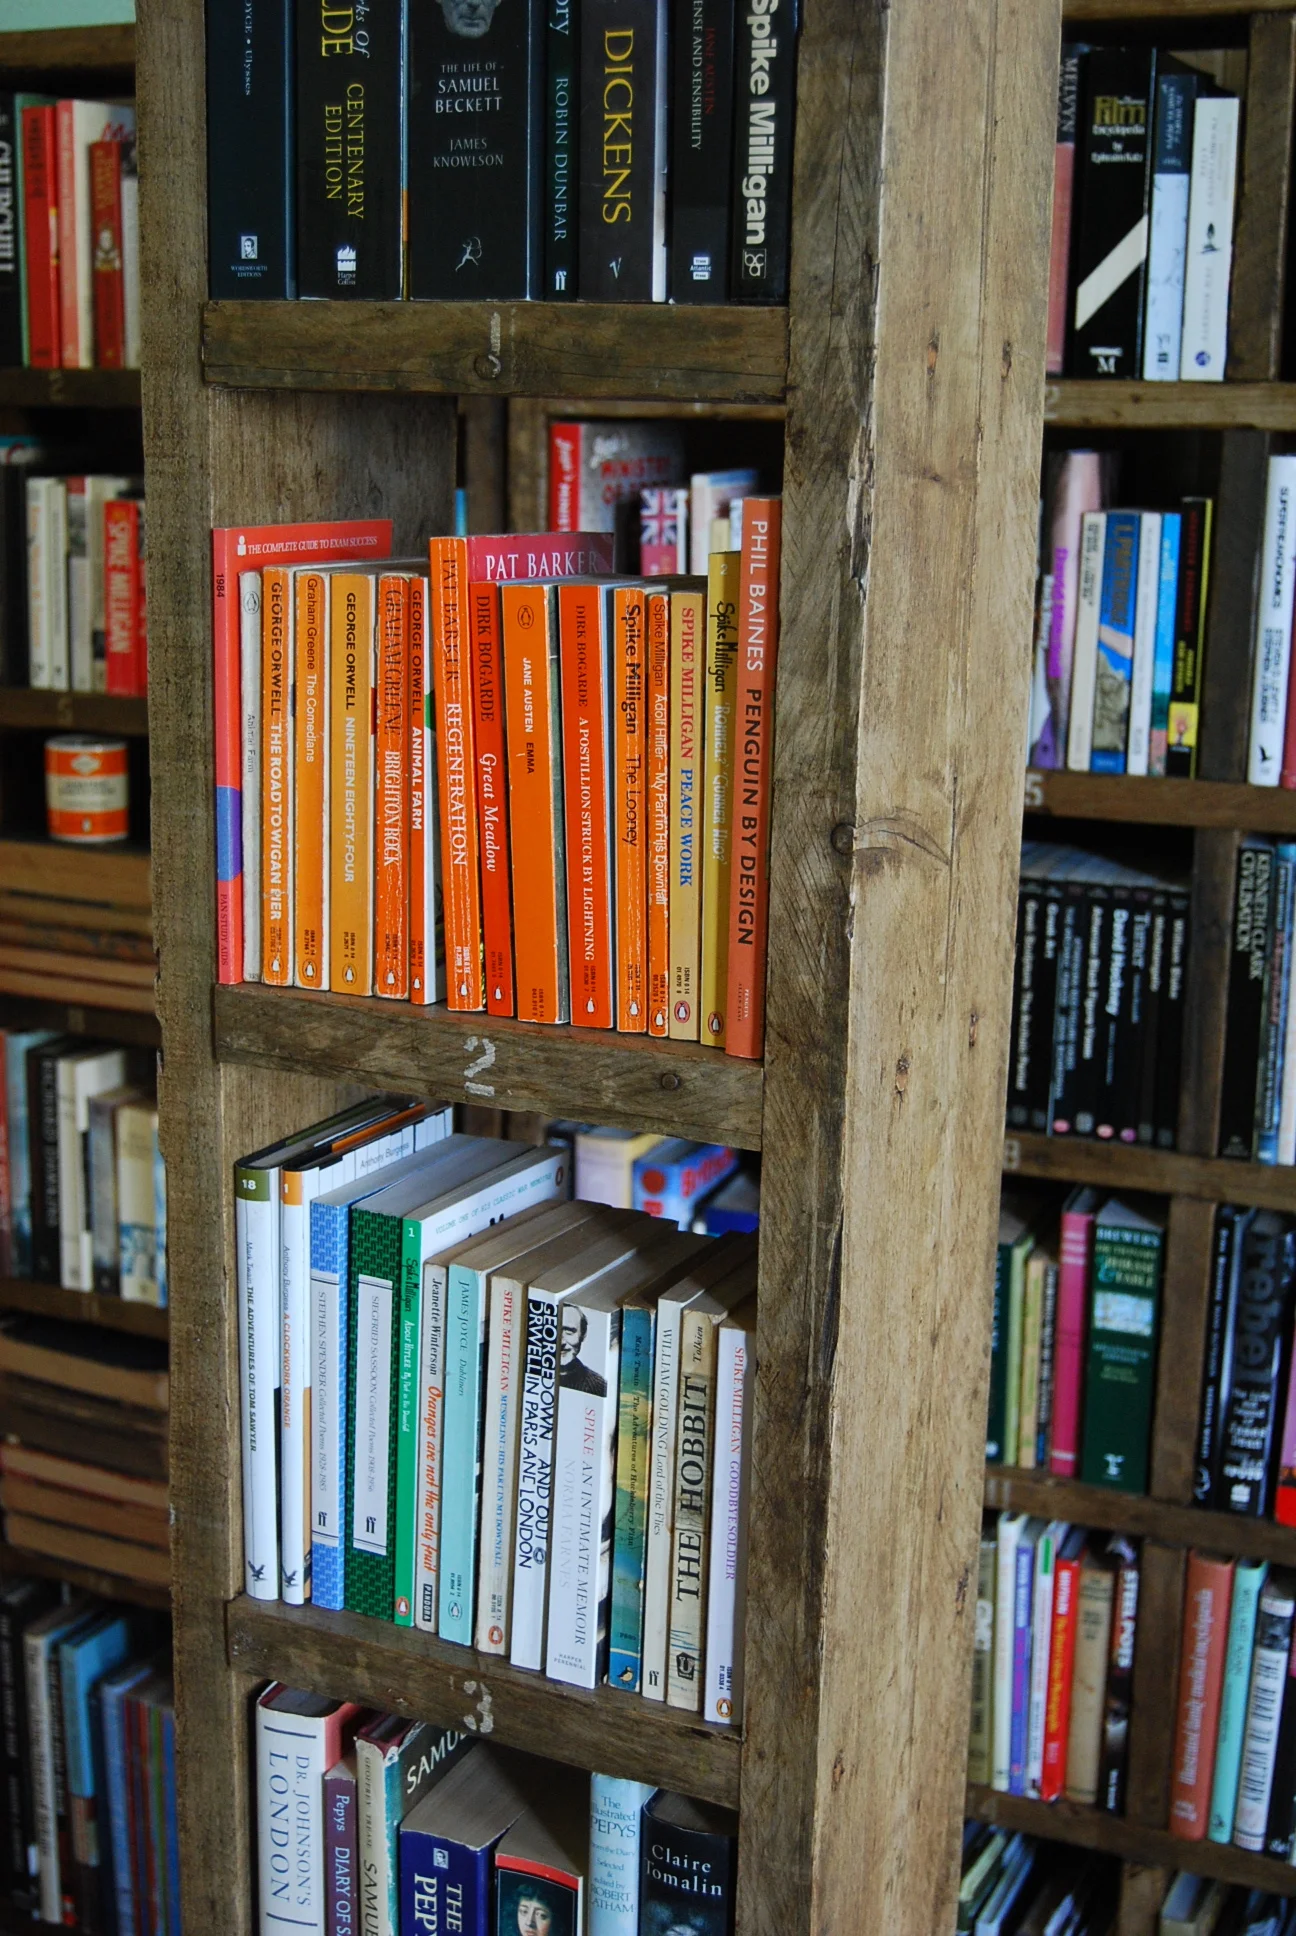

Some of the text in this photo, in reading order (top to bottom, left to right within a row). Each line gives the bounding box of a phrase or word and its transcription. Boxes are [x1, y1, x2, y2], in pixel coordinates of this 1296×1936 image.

[435, 97, 502, 114] BECKETT
[438, 76, 500, 94] SAMUEL
[441, 62, 496, 73] THE LIFE OF
[691, 37, 703, 149] AND SENSIBILITY
[1059, 57, 1079, 133] MELVYN
[325, 105, 342, 200] EDITION
[347, 83, 364, 219] CENTENARY
[433, 155, 504, 168] KNOWLSON
[450, 138, 487, 151] JAMES
[554, 78, 569, 241] ROBIN DUNBAR
[603, 28, 634, 223] DICKENS
[742, 0, 778, 245] Spike Milligan
[216, 573, 225, 598] 1984
[248, 536, 377, 555] THE COMPLETE GUIDE EXAM SUCCESS
[486, 550, 598, 580] PAT BARKER
[271, 582, 282, 646] GEORGE
[576, 605, 587, 639] DIRK
[708, 600, 738, 693] Spike Milligan
[271, 650, 282, 716] ORWELL
[306, 578, 318, 762] Graham Greene The Comedians
[576, 645, 588, 707] BOGARDE
[652, 604, 668, 725] Spike Milligan Adolf
[270, 722, 282, 755] THE
[344, 592, 356, 882] GEORGE ORWELL NINETEEN EIGHTY-FOUR
[384, 589, 403, 867] GRAHAM BRIGHTON ROCK
[411, 590, 423, 830] GEORGE ORWELL ANIMAL FARM
[443, 559, 468, 866] PAT BARKER REGENERATION
[476, 595, 500, 872] DIRK BOGARDE Great Meadow
[522, 657, 535, 774] JANE AUSTEN EMMA
[621, 604, 641, 847] Spike Milligan The Looney
[680, 607, 694, 887] SPIKE MILLIGAN PEACE WORK
[737, 520, 768, 946] PHIL BAINES PENGUIN BY DESIGN
[270, 756, 282, 803] ROAD
[579, 728, 593, 809] POSTILLION
[270, 828, 282, 885] WIGAN
[581, 810, 592, 866] STRUCK
[582, 869, 593, 886] BY
[270, 887, 282, 921] PIER
[583, 888, 595, 961] LIGHTNING
[1249, 853, 1271, 981] KENNETH CLARK
[463, 1036, 496, 1097] 2
[242, 1178, 256, 1190] 18
[248, 1307, 256, 1370] ADVENTURES
[283, 1322, 291, 1385] CLOCKWORK
[319, 1291, 327, 1387] STEPHEN SPENDER
[369, 1295, 380, 1393] SIEGFRIED SASSOON
[456, 1280, 470, 1350] JAMES JOYCE
[501, 1290, 513, 1391] SPIKE MILLIGAN
[541, 1302, 558, 1380] GEORGE
[692, 1326, 703, 1363] Tolkien
[420, 1278, 443, 1573] Jeanette Winterson Oranges are not the only fruit
[656, 1328, 673, 1478] WILLIAM GOLDING Lord
[536, 1378, 556, 1542] DOWN AND OUT
[676, 1375, 707, 1602] THE HOBBIT
[725, 1346, 744, 1580] SPIKE MILLIGAN GOODBYE SOLDIER
[519, 1489, 535, 1569] LONDON
[574, 1407, 596, 1646] SPIKE AN INTIMATE MEMOIR
[424, 1585, 432, 1621] PANDORA
[269, 1751, 290, 1903] LONDON
[292, 1755, 311, 1906] DR. JOHNSON'S
[601, 1795, 621, 1809] The
[333, 1794, 351, 1923] Pepys DIARY OF
[644, 1857, 723, 1896] Tomalin
[652, 1845, 712, 1873] Claire
[446, 1883, 462, 1932] THE
